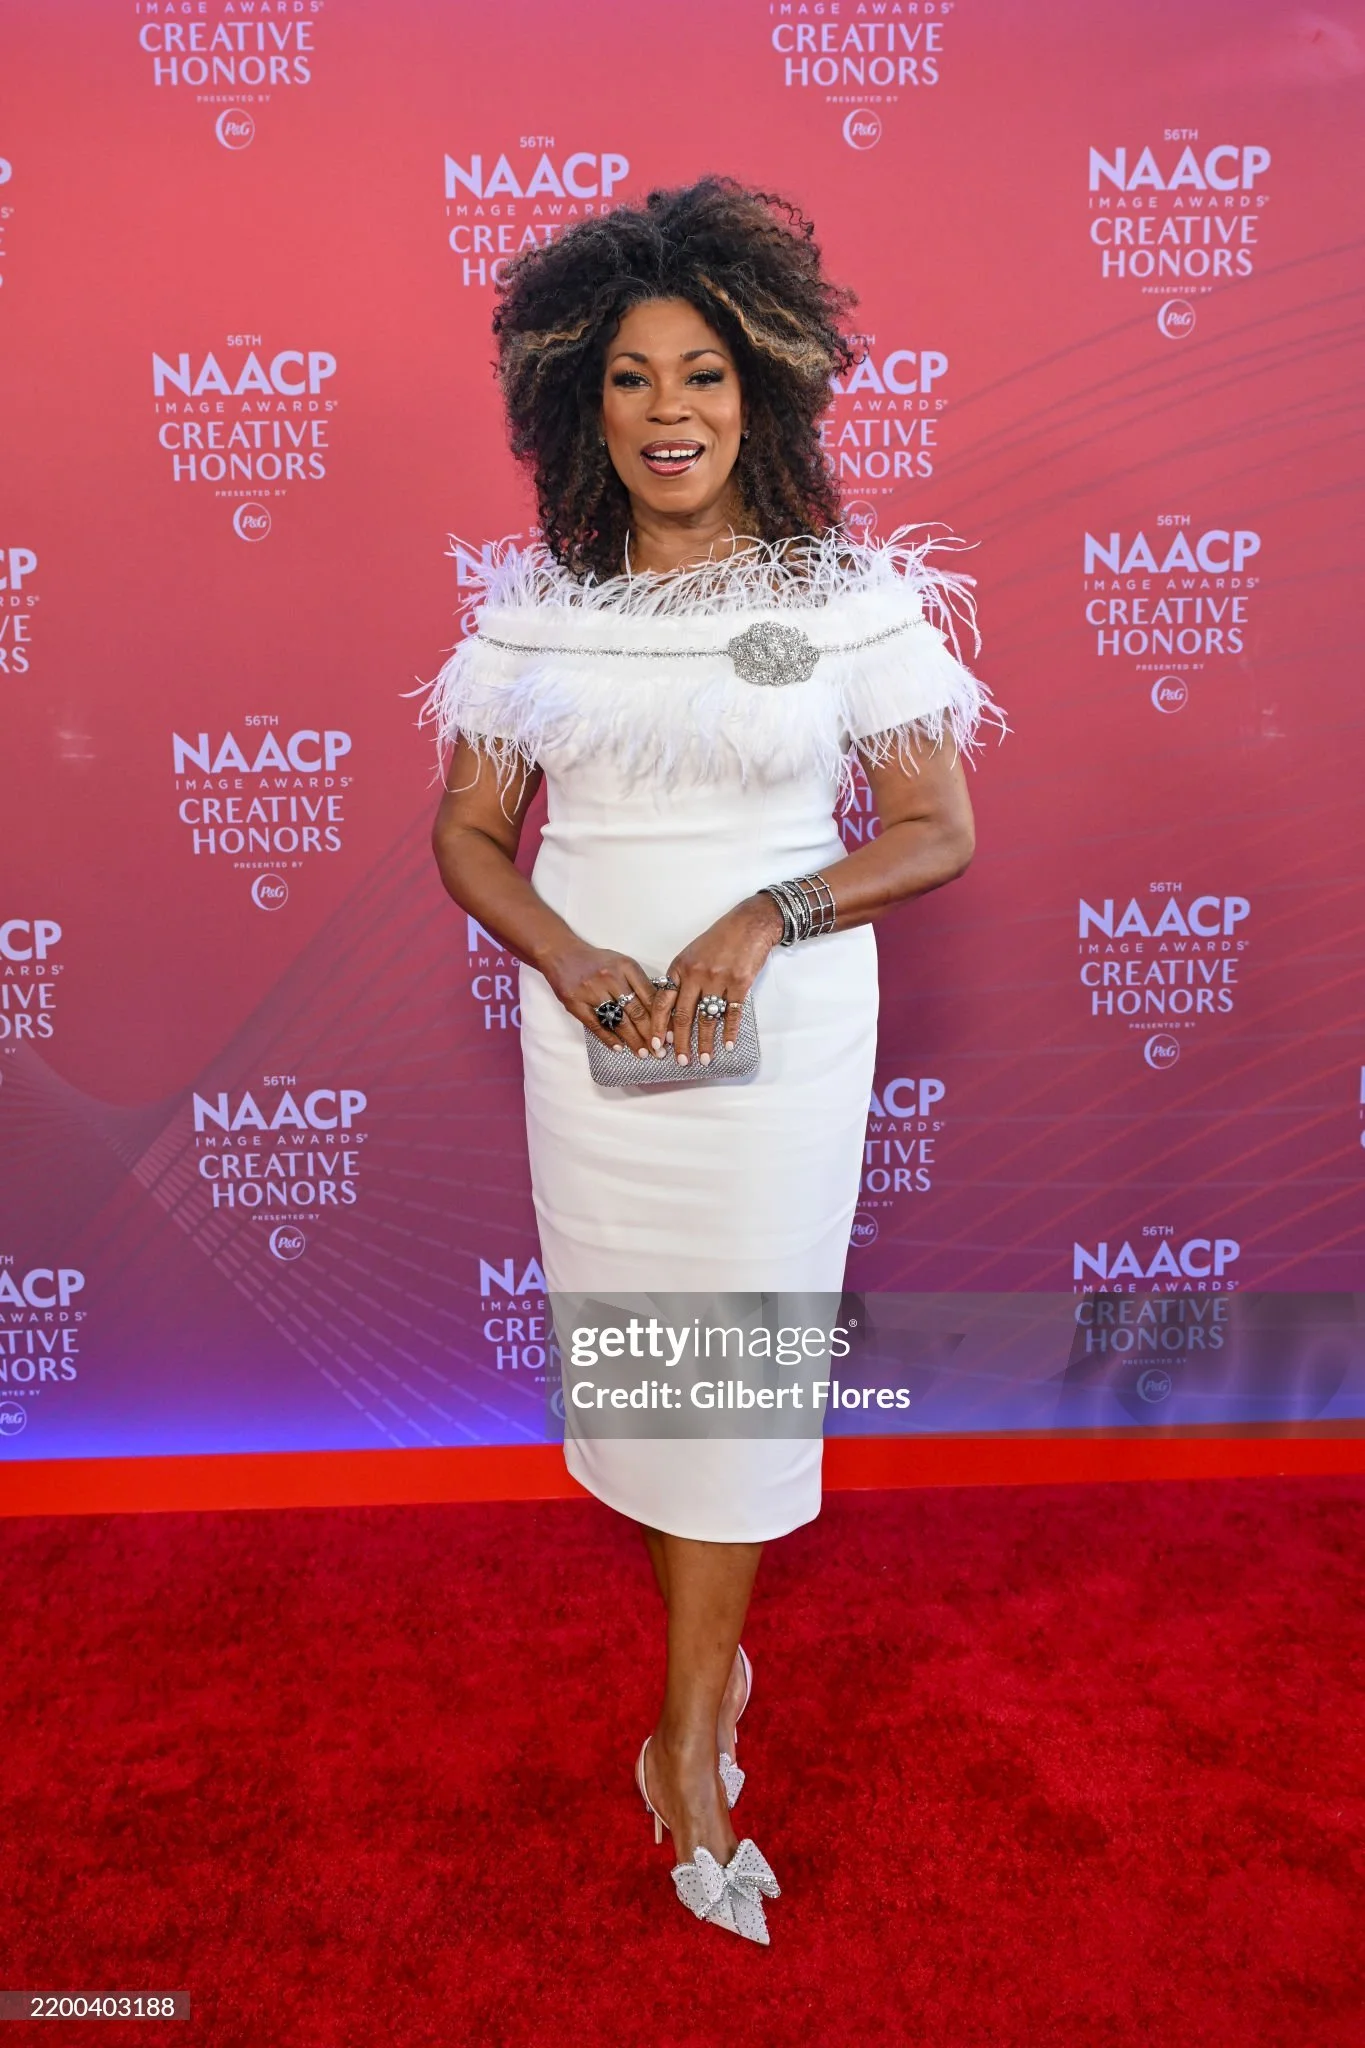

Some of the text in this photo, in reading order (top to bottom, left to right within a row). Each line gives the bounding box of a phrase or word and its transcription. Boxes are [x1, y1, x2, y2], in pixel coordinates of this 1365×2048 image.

[135, 2, 207, 14] IMAGE
[770, 3, 840, 14] IMAGE
[139, 21, 314, 52] CREATIVE
[771, 23, 944, 52] CREATIVE
[154, 56, 311, 86] HONORS
[785, 57, 939, 86] HONORS
[520, 136, 554, 148] 56TH
[1164, 129, 1198, 140] 56TH
[444, 152, 629, 200] NAACP
[1089, 145, 1271, 191] NAACP
[446, 205, 516, 216] IMAGE
[1089, 197, 1158, 209] IMAGE
[449, 224, 561, 253] CREAT
[1090, 216, 1258, 245] CREATIVE
[1102, 248, 1253, 277] HONORS
[227, 335, 261, 346] 56TH
[152, 351, 337, 397] NAACP
[828, 350, 949, 394] ACP
[155, 402, 224, 413] IMAGE
[159, 420, 328, 449] CREATIVE
[818, 419, 937, 447] EATIVE
[173, 453, 326, 481] HONORS
[823, 451, 933, 478] NORS
[1157, 515, 1190, 526] 56TH
[1084, 530, 1261, 574] NAACP
[1084, 580, 1150, 591] IMAGE
[1086, 597, 1248, 625] CREATIVE
[1098, 628, 1243, 656] HONORS
[245, 716, 279, 726] 56TH
[173, 730, 352, 775] NAACP
[175, 779, 243, 790] IMAGE
[179, 795, 344, 824] CREATIVE
[193, 826, 341, 854] HONORS
[1150, 882, 1182, 892] 56TH
[1079, 896, 1251, 939] NAACP
[1079, 943, 1144, 954] IMAGE
[5, 965, 60, 976] ARDS
[469, 957, 520, 968] IMAG
[1080, 959, 1239, 986] CREATIVE
[1092, 988, 1233, 1016] HONORS
[264, 1076, 296, 1086] 56TH
[193, 1089, 367, 1132] NAACP
[870, 1122, 941, 1132] WARDS
[195, 1136, 262, 1147] IMAGE
[199, 1151, 360, 1179] CREATIVE
[213, 1180, 357, 1208] HONORS
[1142, 1226, 1174, 1236] 56TH
[1073, 1239, 1240, 1280] NAACP
[1073, 1284, 1136, 1294] IMAGE
[481, 1301, 545, 1311] IMAGE
[1074, 1298, 1229, 1325] CREATIVE
[1086, 1326, 1224, 1352] HONORS
